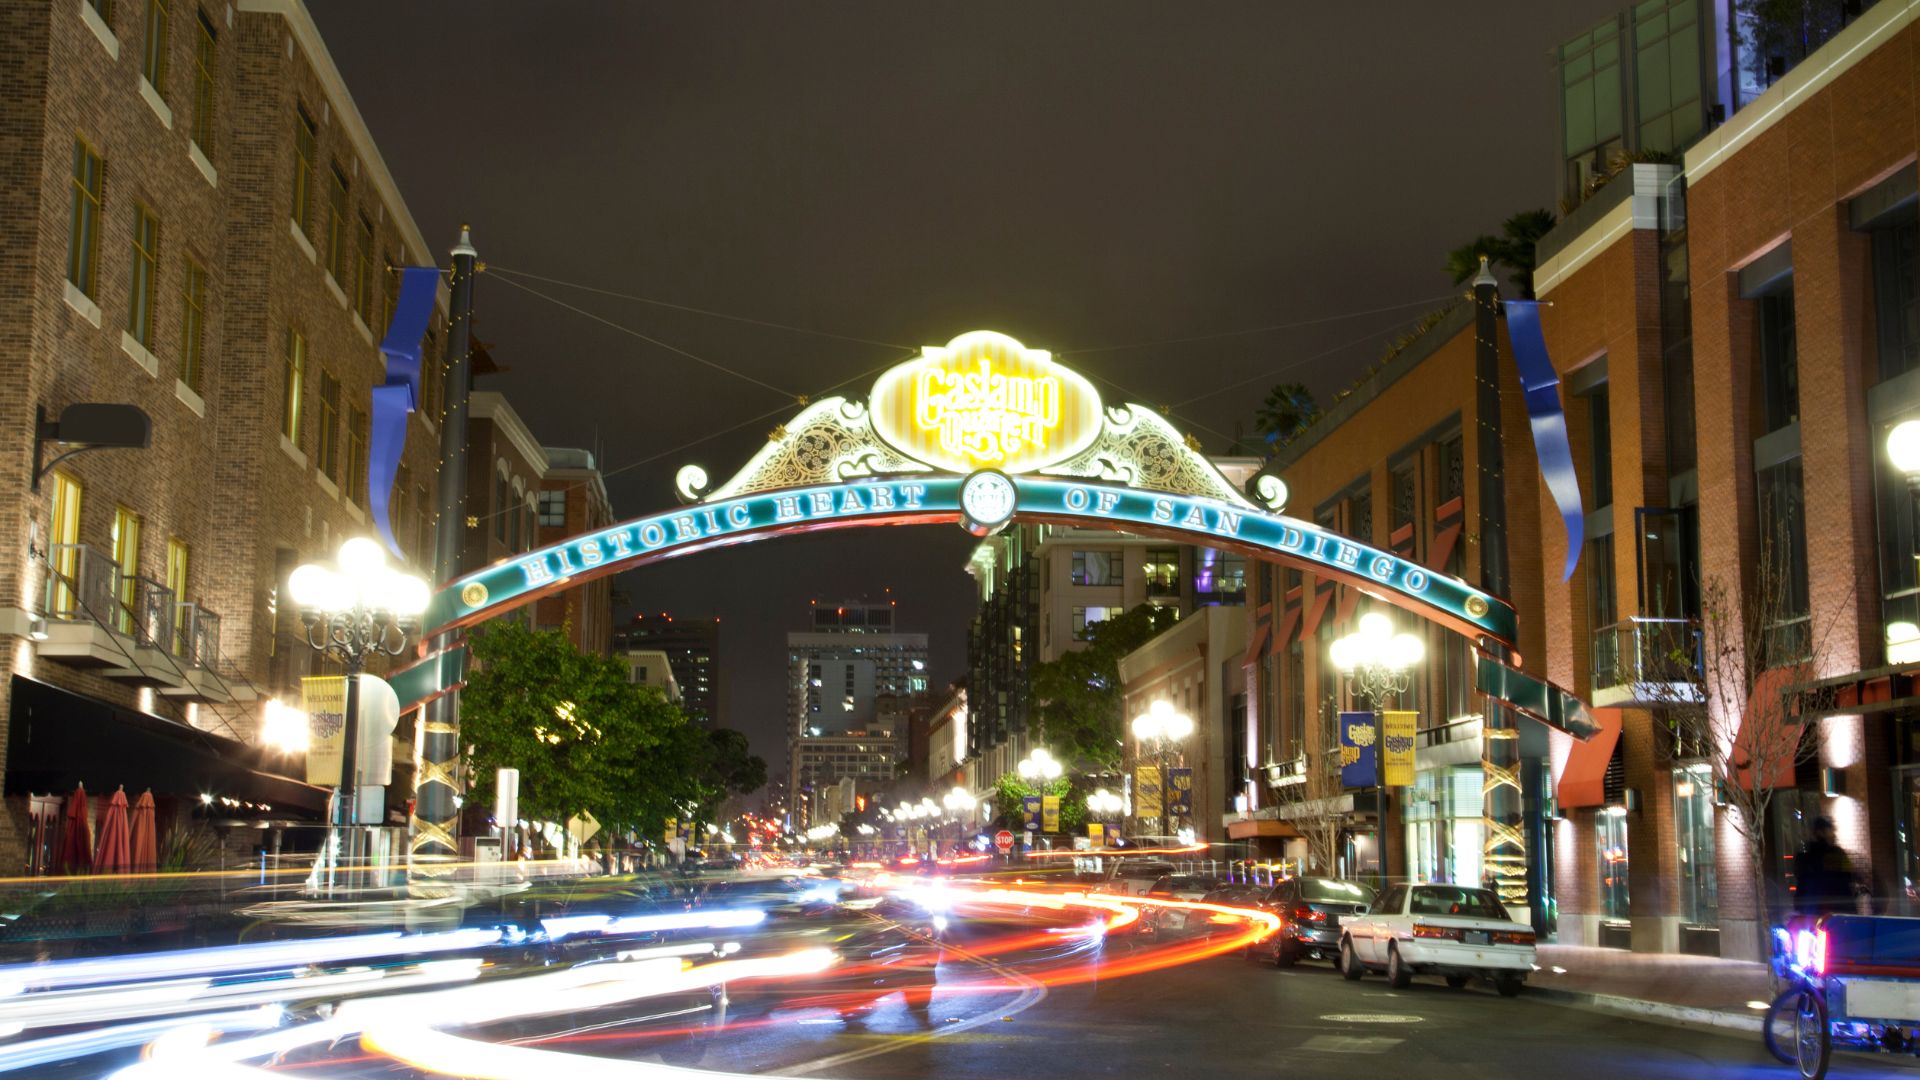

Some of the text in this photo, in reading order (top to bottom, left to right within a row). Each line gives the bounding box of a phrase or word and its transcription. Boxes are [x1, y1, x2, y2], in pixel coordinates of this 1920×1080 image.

[916, 359, 1059, 429] Gaslamp
[522, 485, 1429, 591] HISTORIC HEART OF SAN DIEGO
[307, 694, 344, 703] WELCOME
[995, 836, 1013, 845] STOP
